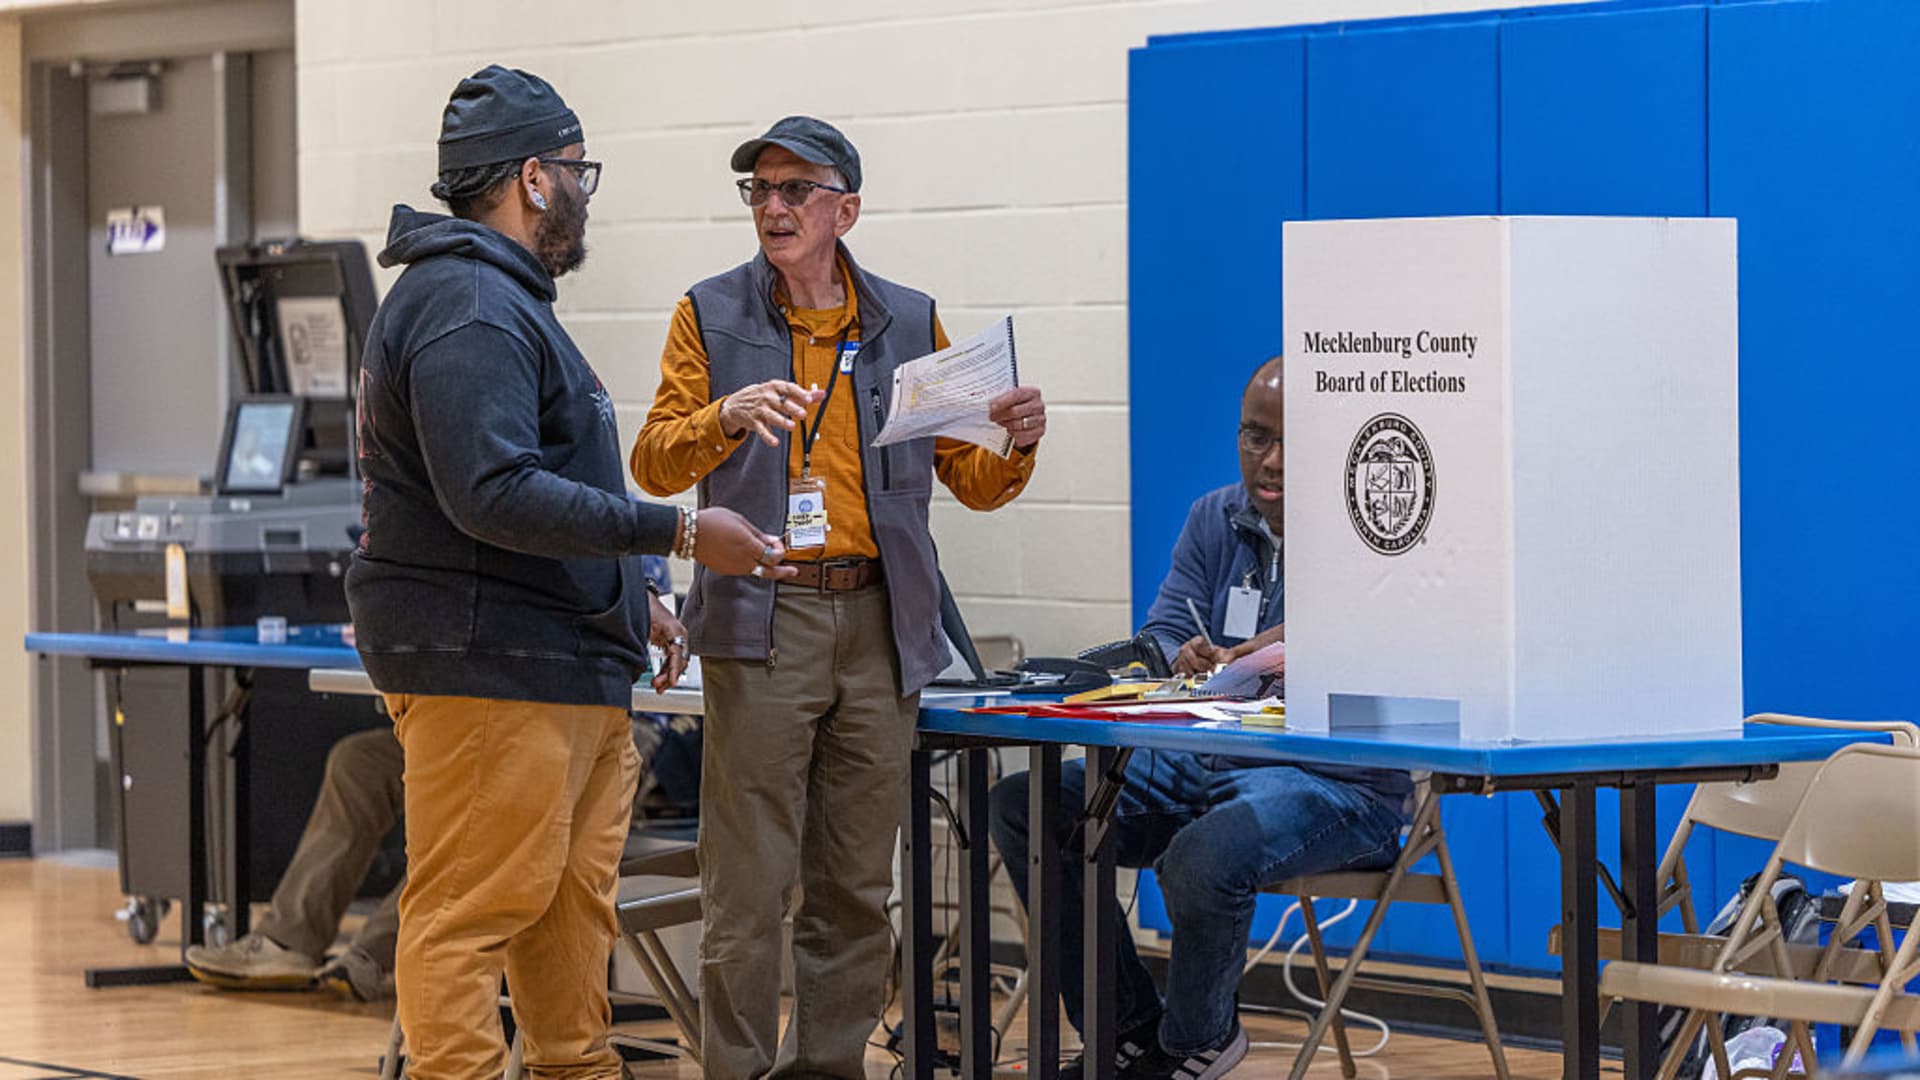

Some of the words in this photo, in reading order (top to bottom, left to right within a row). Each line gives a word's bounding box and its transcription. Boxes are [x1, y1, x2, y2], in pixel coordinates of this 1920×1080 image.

[1304, 331, 1412, 359] Mecklenburg
[1416, 330, 1478, 359] County
[1315, 370, 1365, 393] Board
[1370, 370, 1388, 393] of
[1392, 370, 1466, 393] Elections
